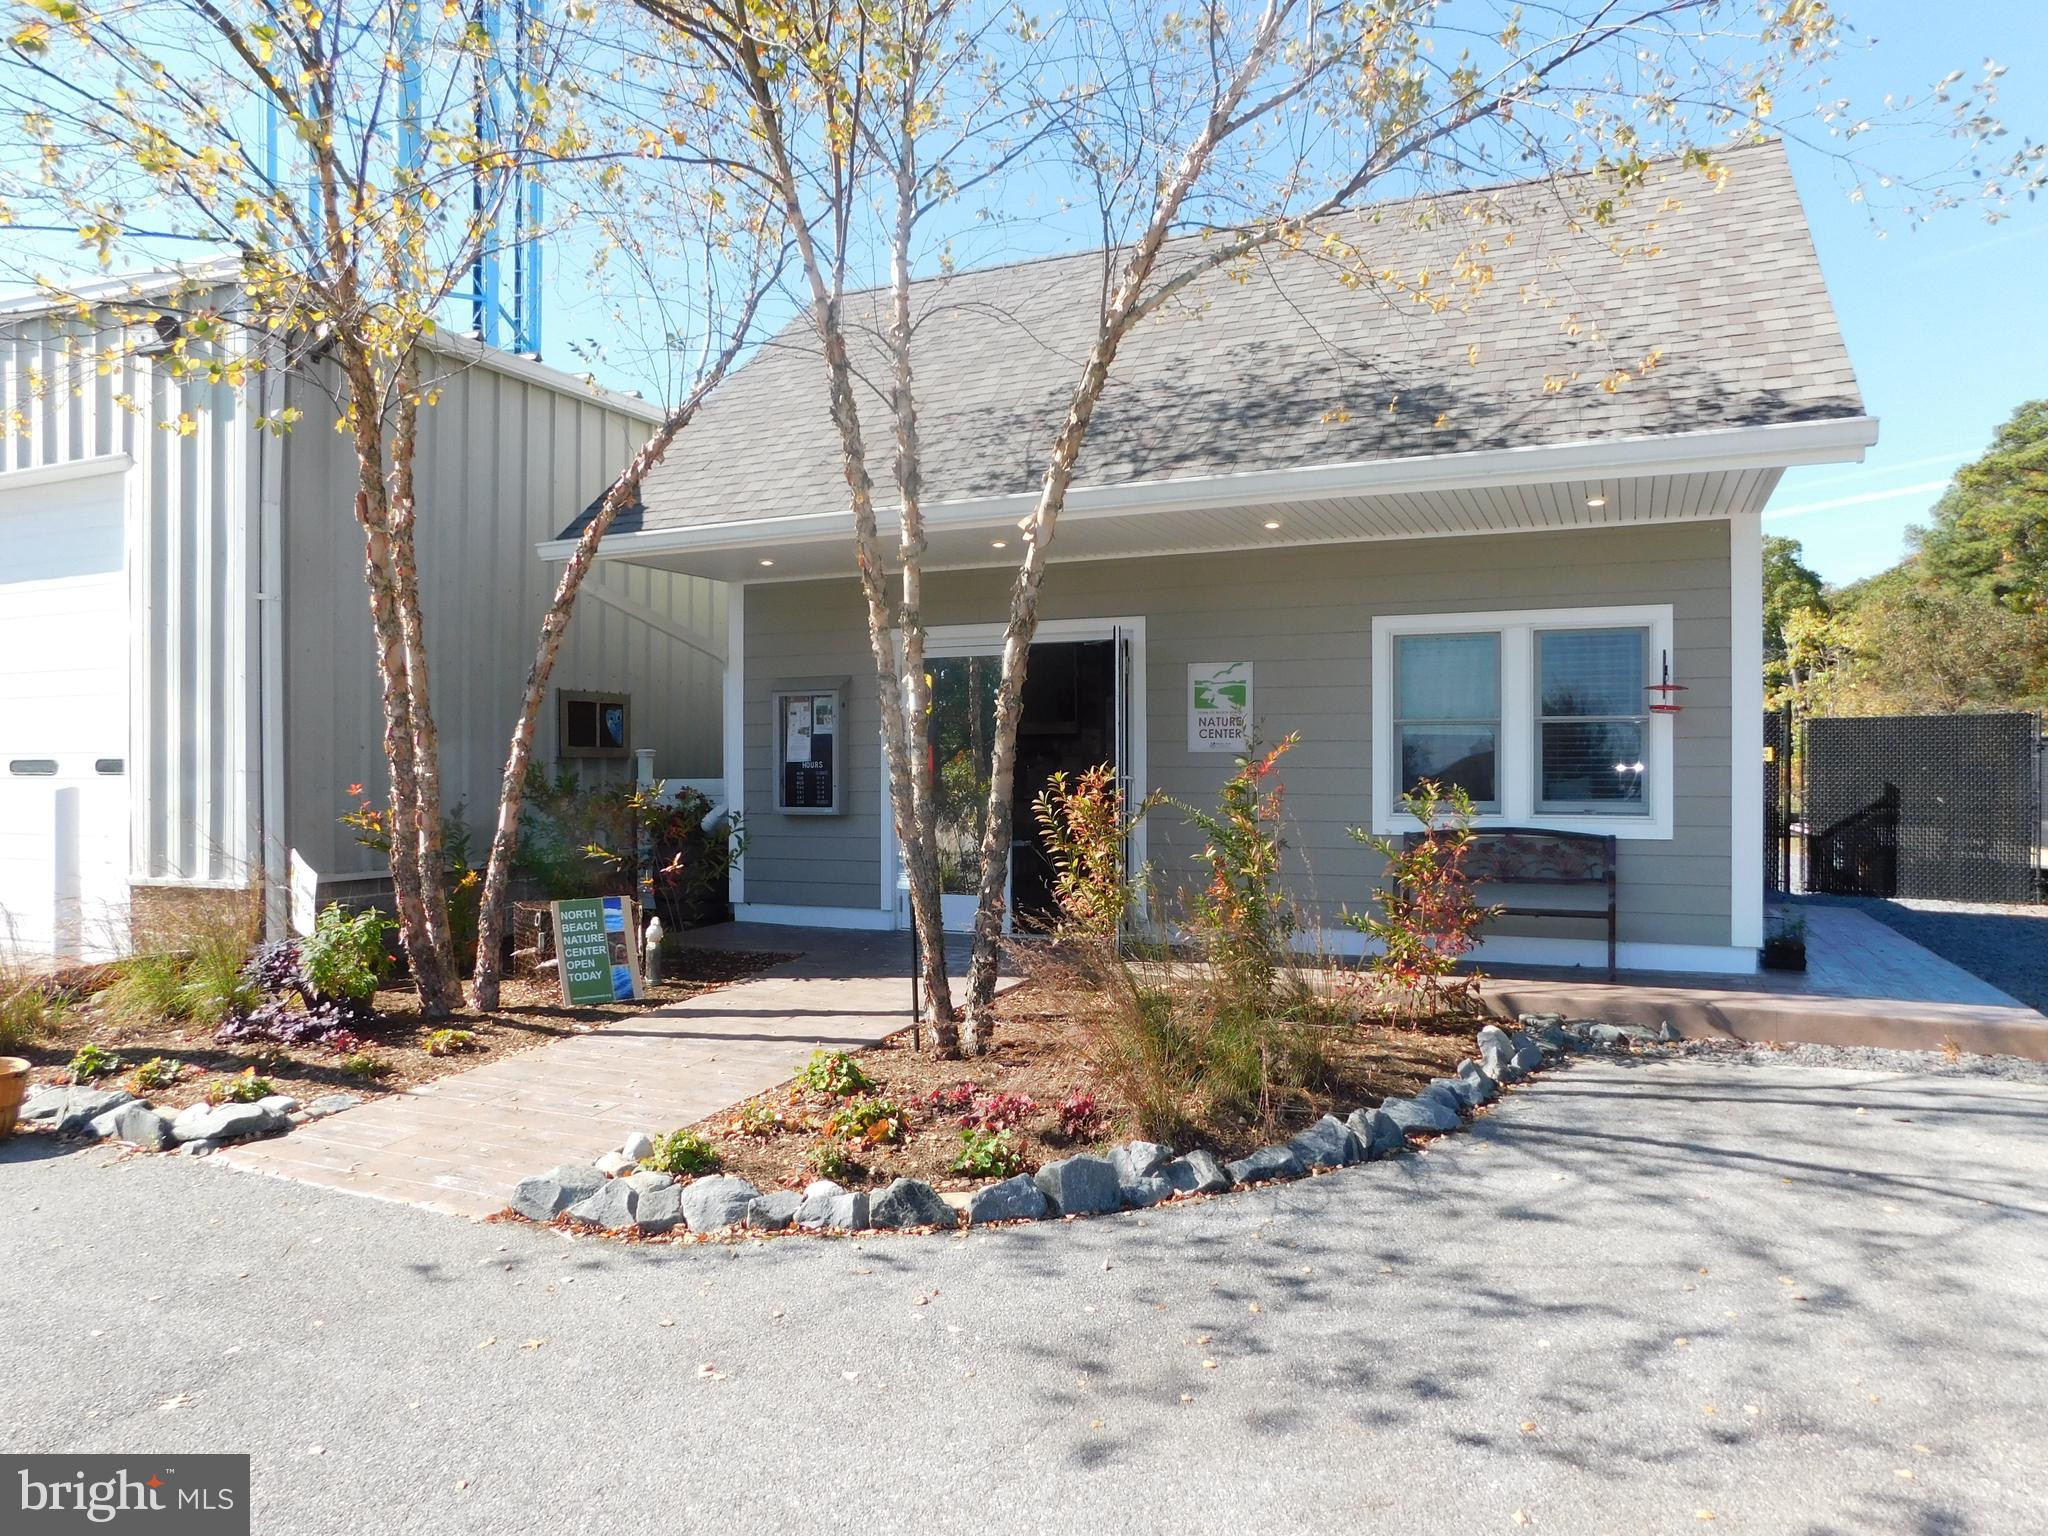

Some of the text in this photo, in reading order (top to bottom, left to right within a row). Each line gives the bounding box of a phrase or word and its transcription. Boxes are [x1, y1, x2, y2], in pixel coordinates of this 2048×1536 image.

[1199, 717, 1242, 726] NATURE
[1199, 729, 1241, 738] CENTER
[560, 909, 597, 920] NORTH
[562, 921, 598, 933] BEACH
[563, 933, 605, 945] NATURE
[565, 945, 607, 957] CENTER
[566, 959, 596, 970] OPEN
[568, 970, 603, 982] TODAY
